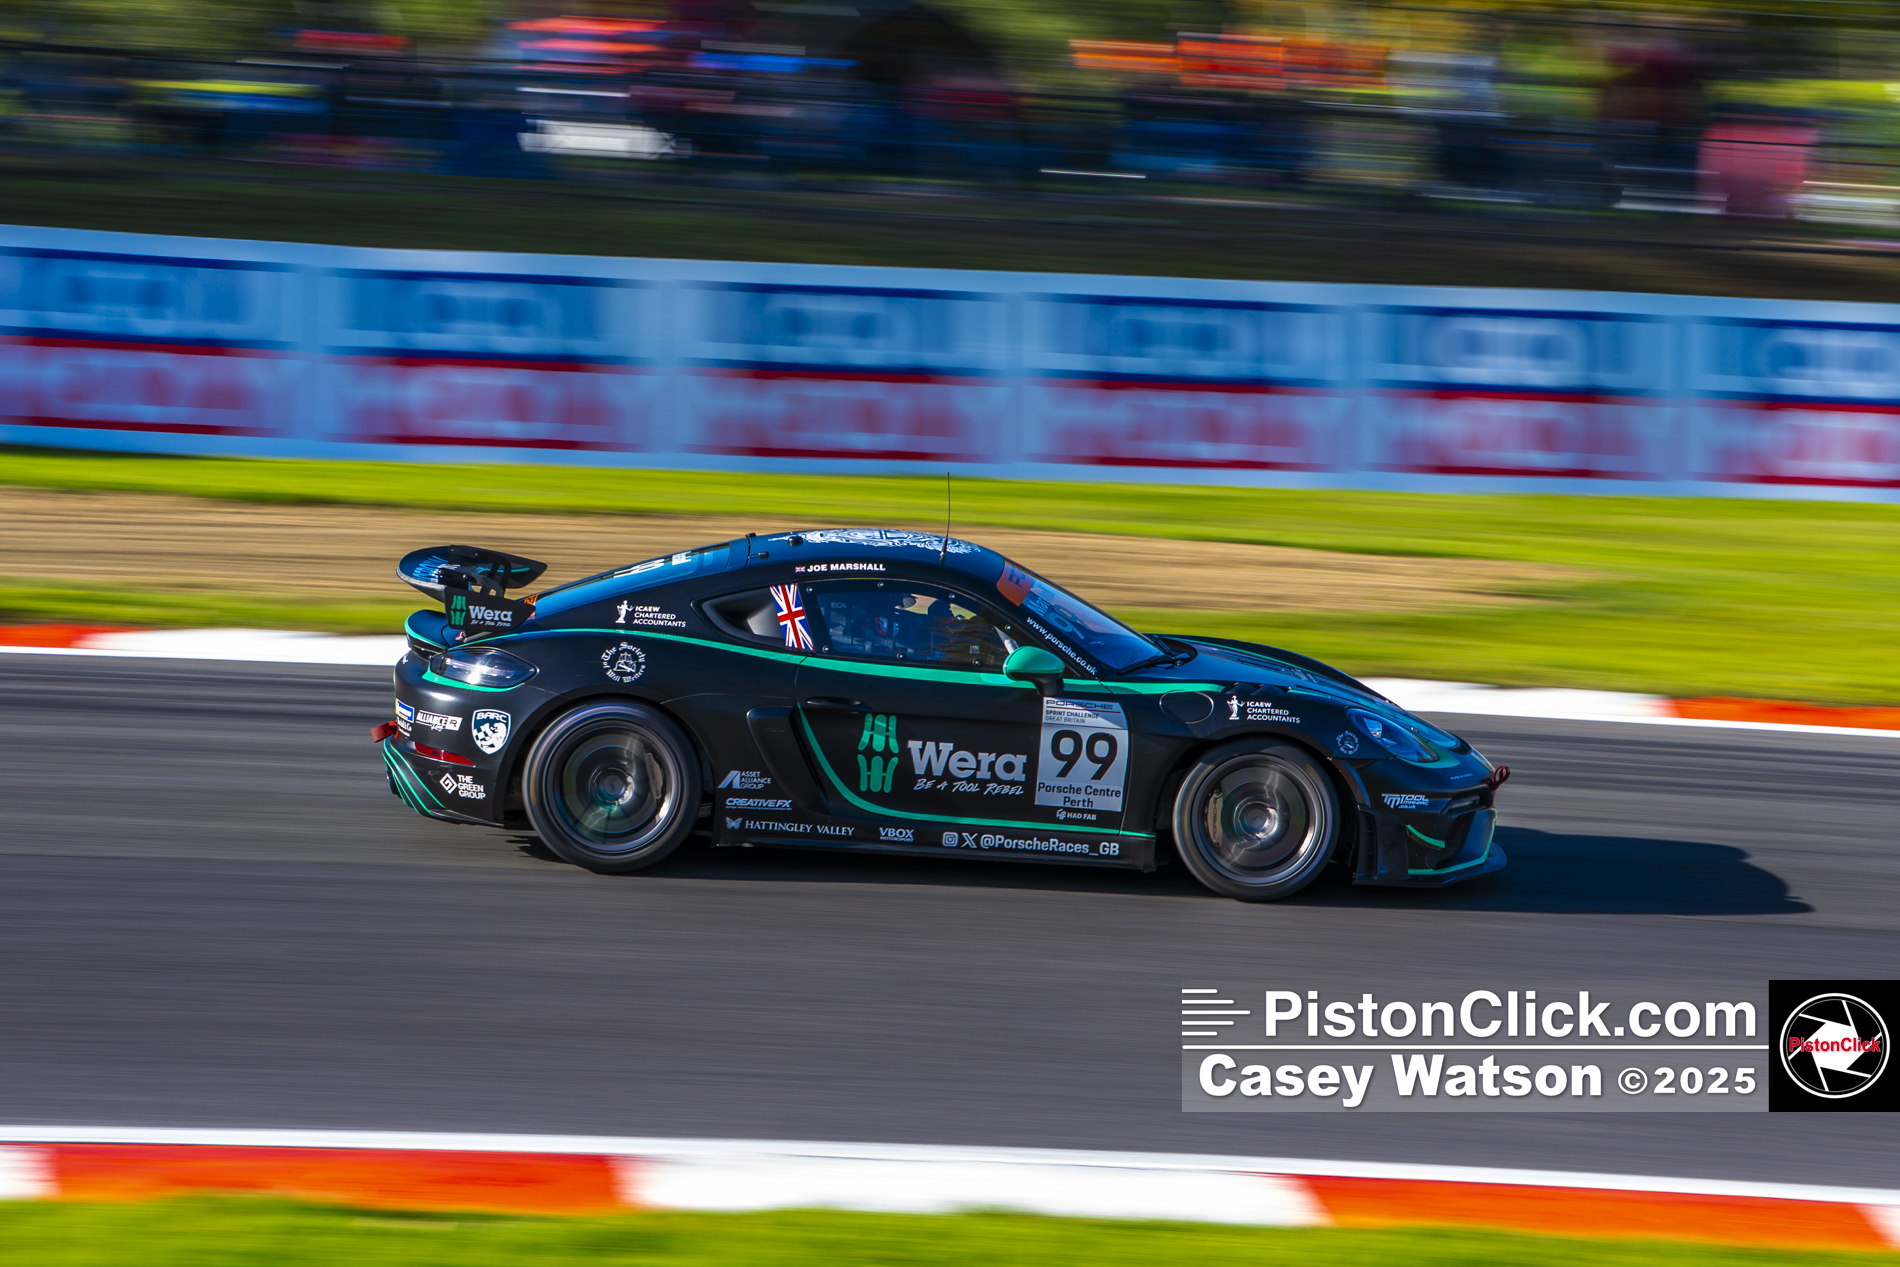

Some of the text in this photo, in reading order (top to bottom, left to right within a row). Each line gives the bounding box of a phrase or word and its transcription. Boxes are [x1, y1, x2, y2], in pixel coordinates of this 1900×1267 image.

[807, 563, 886, 573] JOE MARSHALL
[468, 605, 513, 622] Wera
[634, 612, 676, 620] CHARTERED
[632, 618, 687, 628] ACCOUNTANTS
[601, 646, 617, 661] The
[618, 641, 647, 663] Society
[1026, 616, 1098, 676] www.porsche.co.uk
[1045, 699, 1114, 711] PORSCHE
[476, 711, 507, 724] BARC
[1045, 709, 1099, 720] SPRINT CHALLENGE
[1246, 707, 1290, 716] CHARTERED
[416, 711, 449, 729] ALLIANCE
[1246, 713, 1301, 724] ACCOUNTANTS
[907, 740, 1028, 782] Wera
[1050, 729, 1119, 781] 99
[456, 774, 474, 784] THE
[740, 777, 772, 785] ALLIANCE
[457, 782, 484, 793] GREEN
[913, 778, 1025, 796] BE A TOOL REBEL
[1037, 781, 1122, 798] Porsche Centre
[458, 789, 486, 800] GROUP
[1400, 794, 1429, 802] TOOL
[1063, 796, 1094, 809] Perth
[1067, 812, 1097, 821] HAD FAB
[744, 820, 855, 837] HATTINGLEY VALLEY
[879, 827, 915, 839] VBOX
[980, 833, 1120, 856] @PorscheRaces_GB
